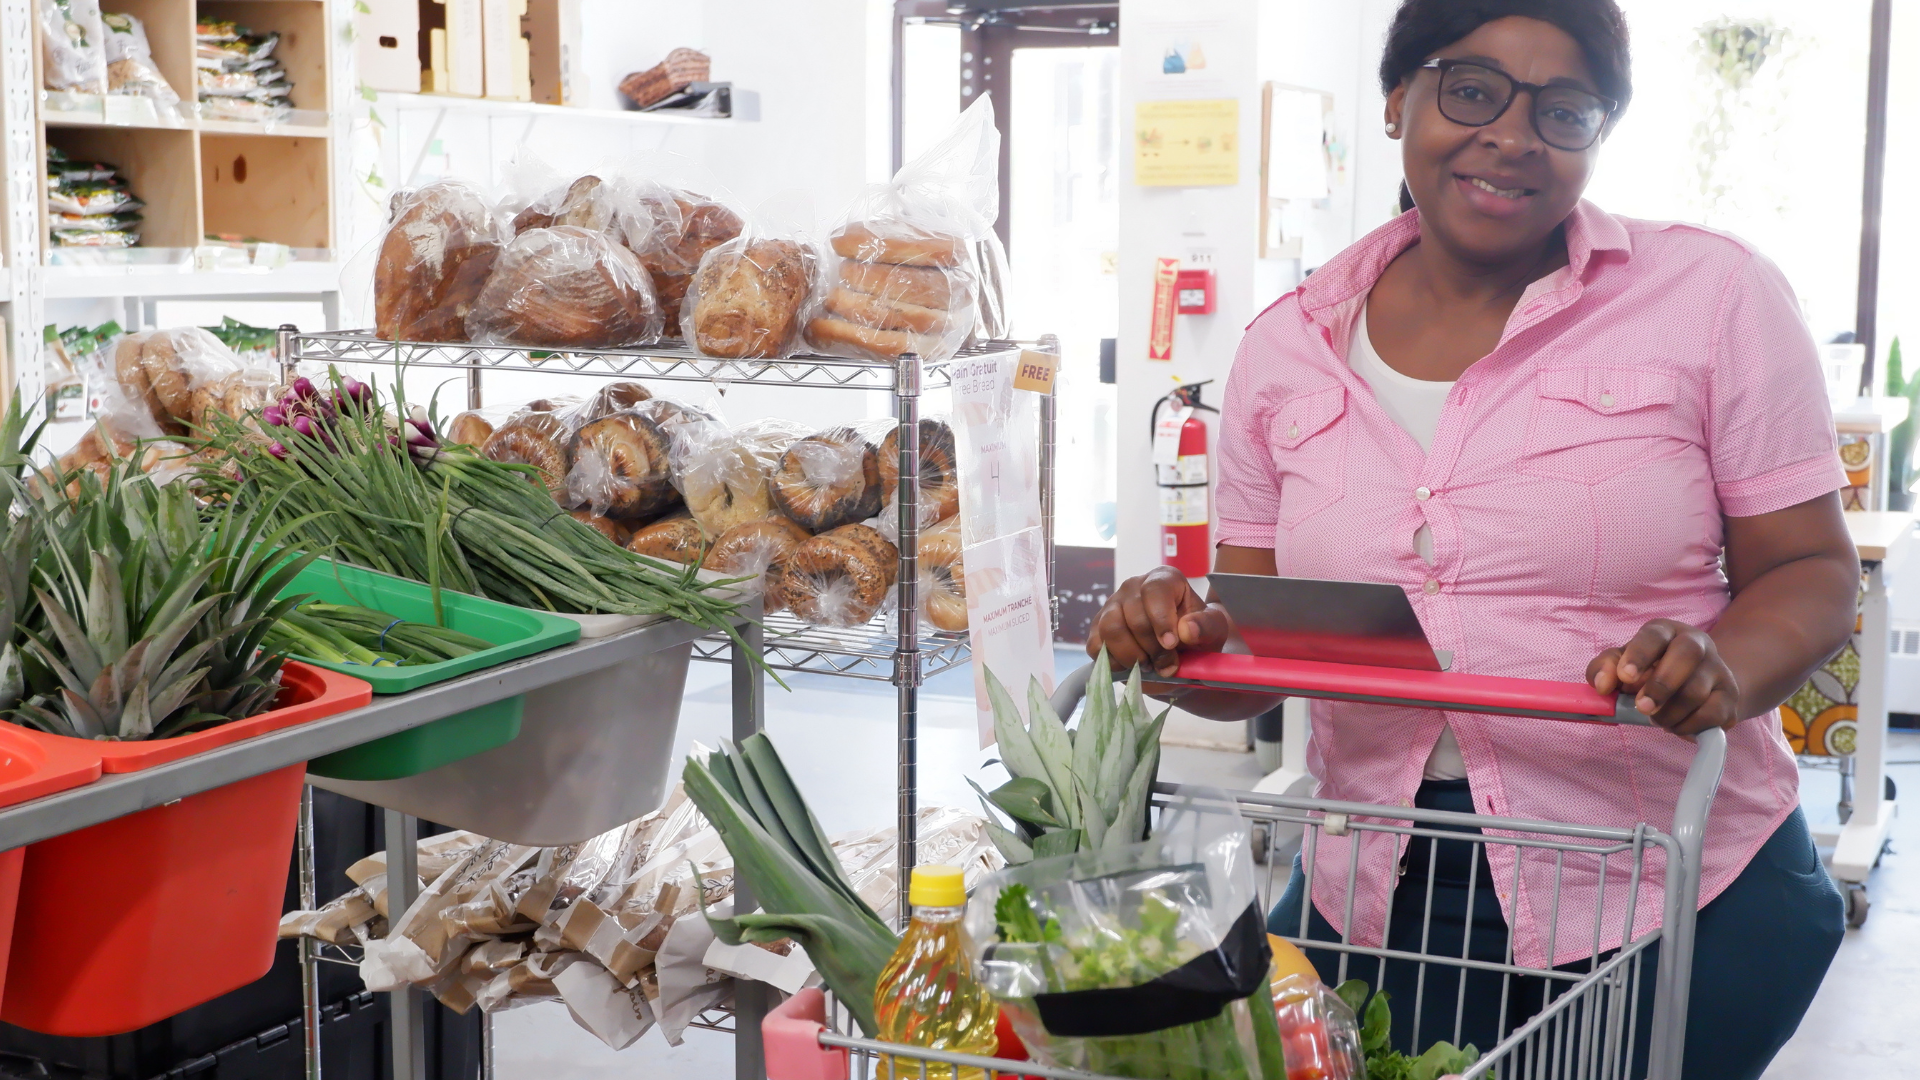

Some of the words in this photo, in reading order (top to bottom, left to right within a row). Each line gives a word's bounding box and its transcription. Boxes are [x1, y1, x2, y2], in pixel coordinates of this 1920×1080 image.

[1191, 254, 1211, 262] 911
[971, 360, 997, 376] Gratuit
[1021, 363, 1050, 381] FREE
[955, 382, 971, 395] Free
[973, 377, 995, 392] Bread
[980, 441, 1006, 453] MAXIMUM
[991, 460, 999, 496] 4
[983, 606, 1007, 624] MAXIMUM
[1008, 595, 1032, 612] TRANCHÉ
[988, 620, 1011, 636] MAXIMUM
[1012, 612, 1030, 627] SLICED
